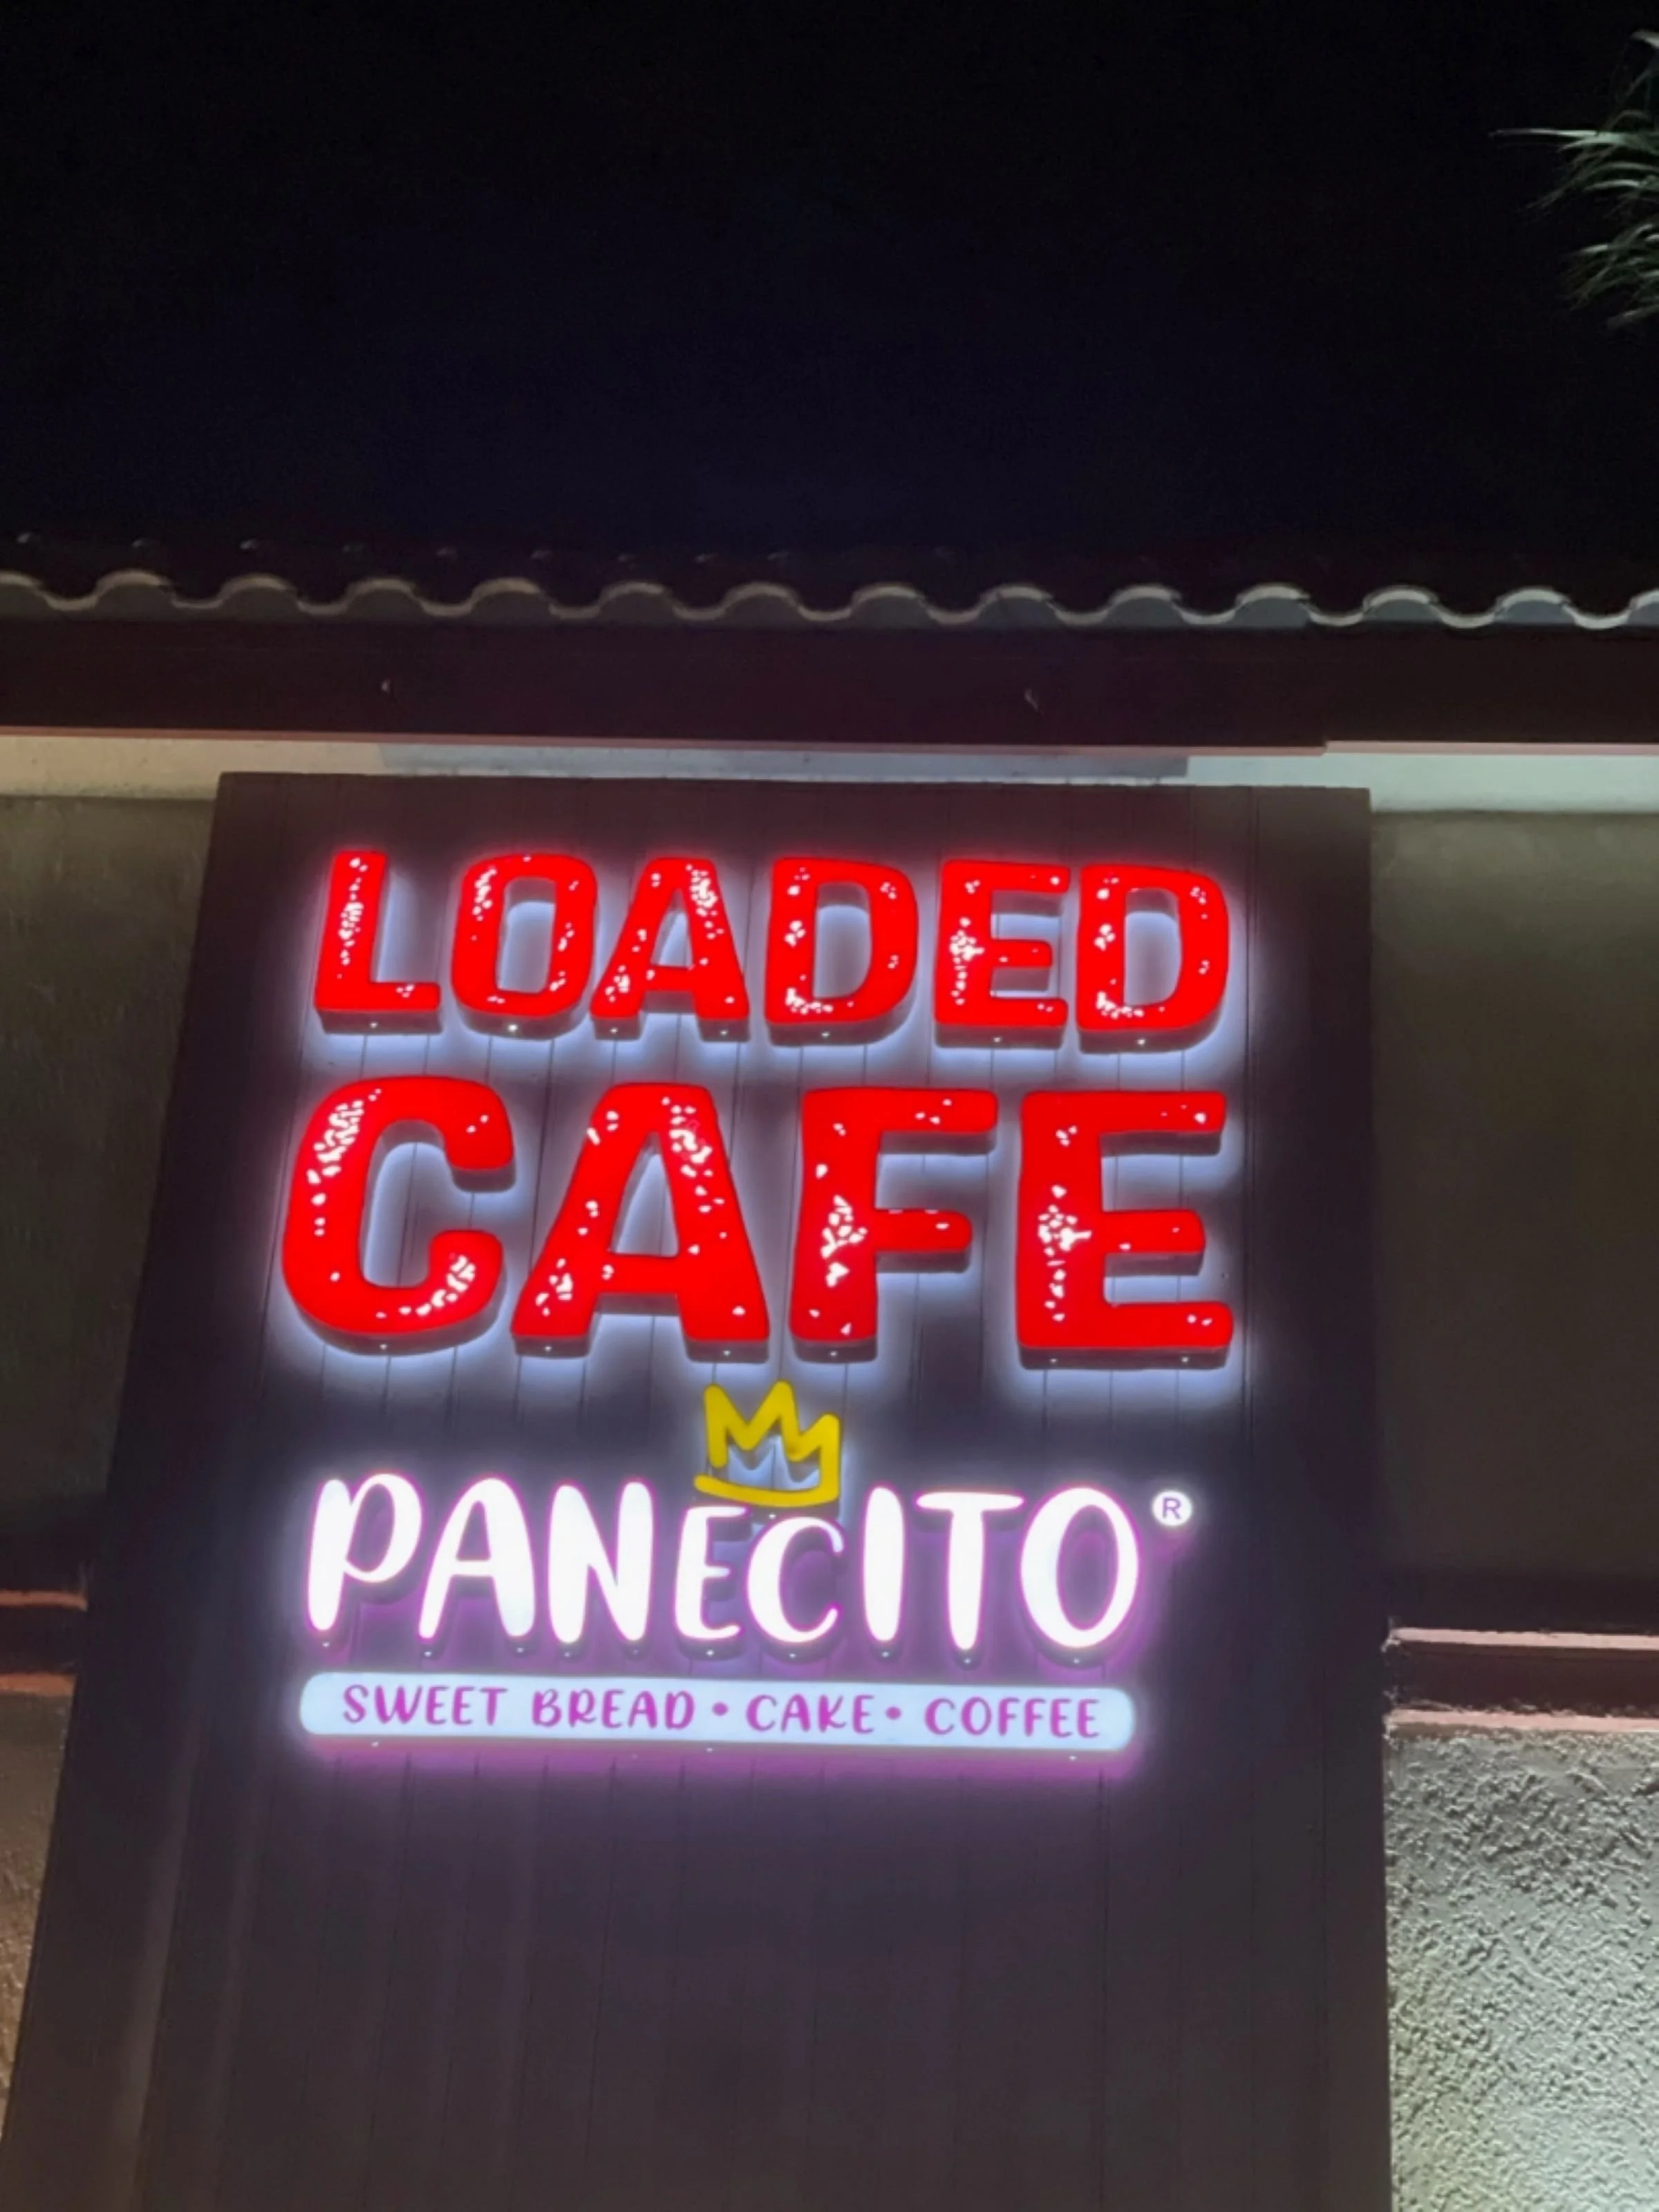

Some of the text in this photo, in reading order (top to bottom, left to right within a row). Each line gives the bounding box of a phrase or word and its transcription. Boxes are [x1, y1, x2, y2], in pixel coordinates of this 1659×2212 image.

[313, 850, 1230, 1031] LOADED
[282, 1076, 1235, 1349] CAFE
[307, 1473, 1139, 1649] PANECITO
[342, 1684, 1100, 1738] SWEET BREAD CAKE COFFEE
